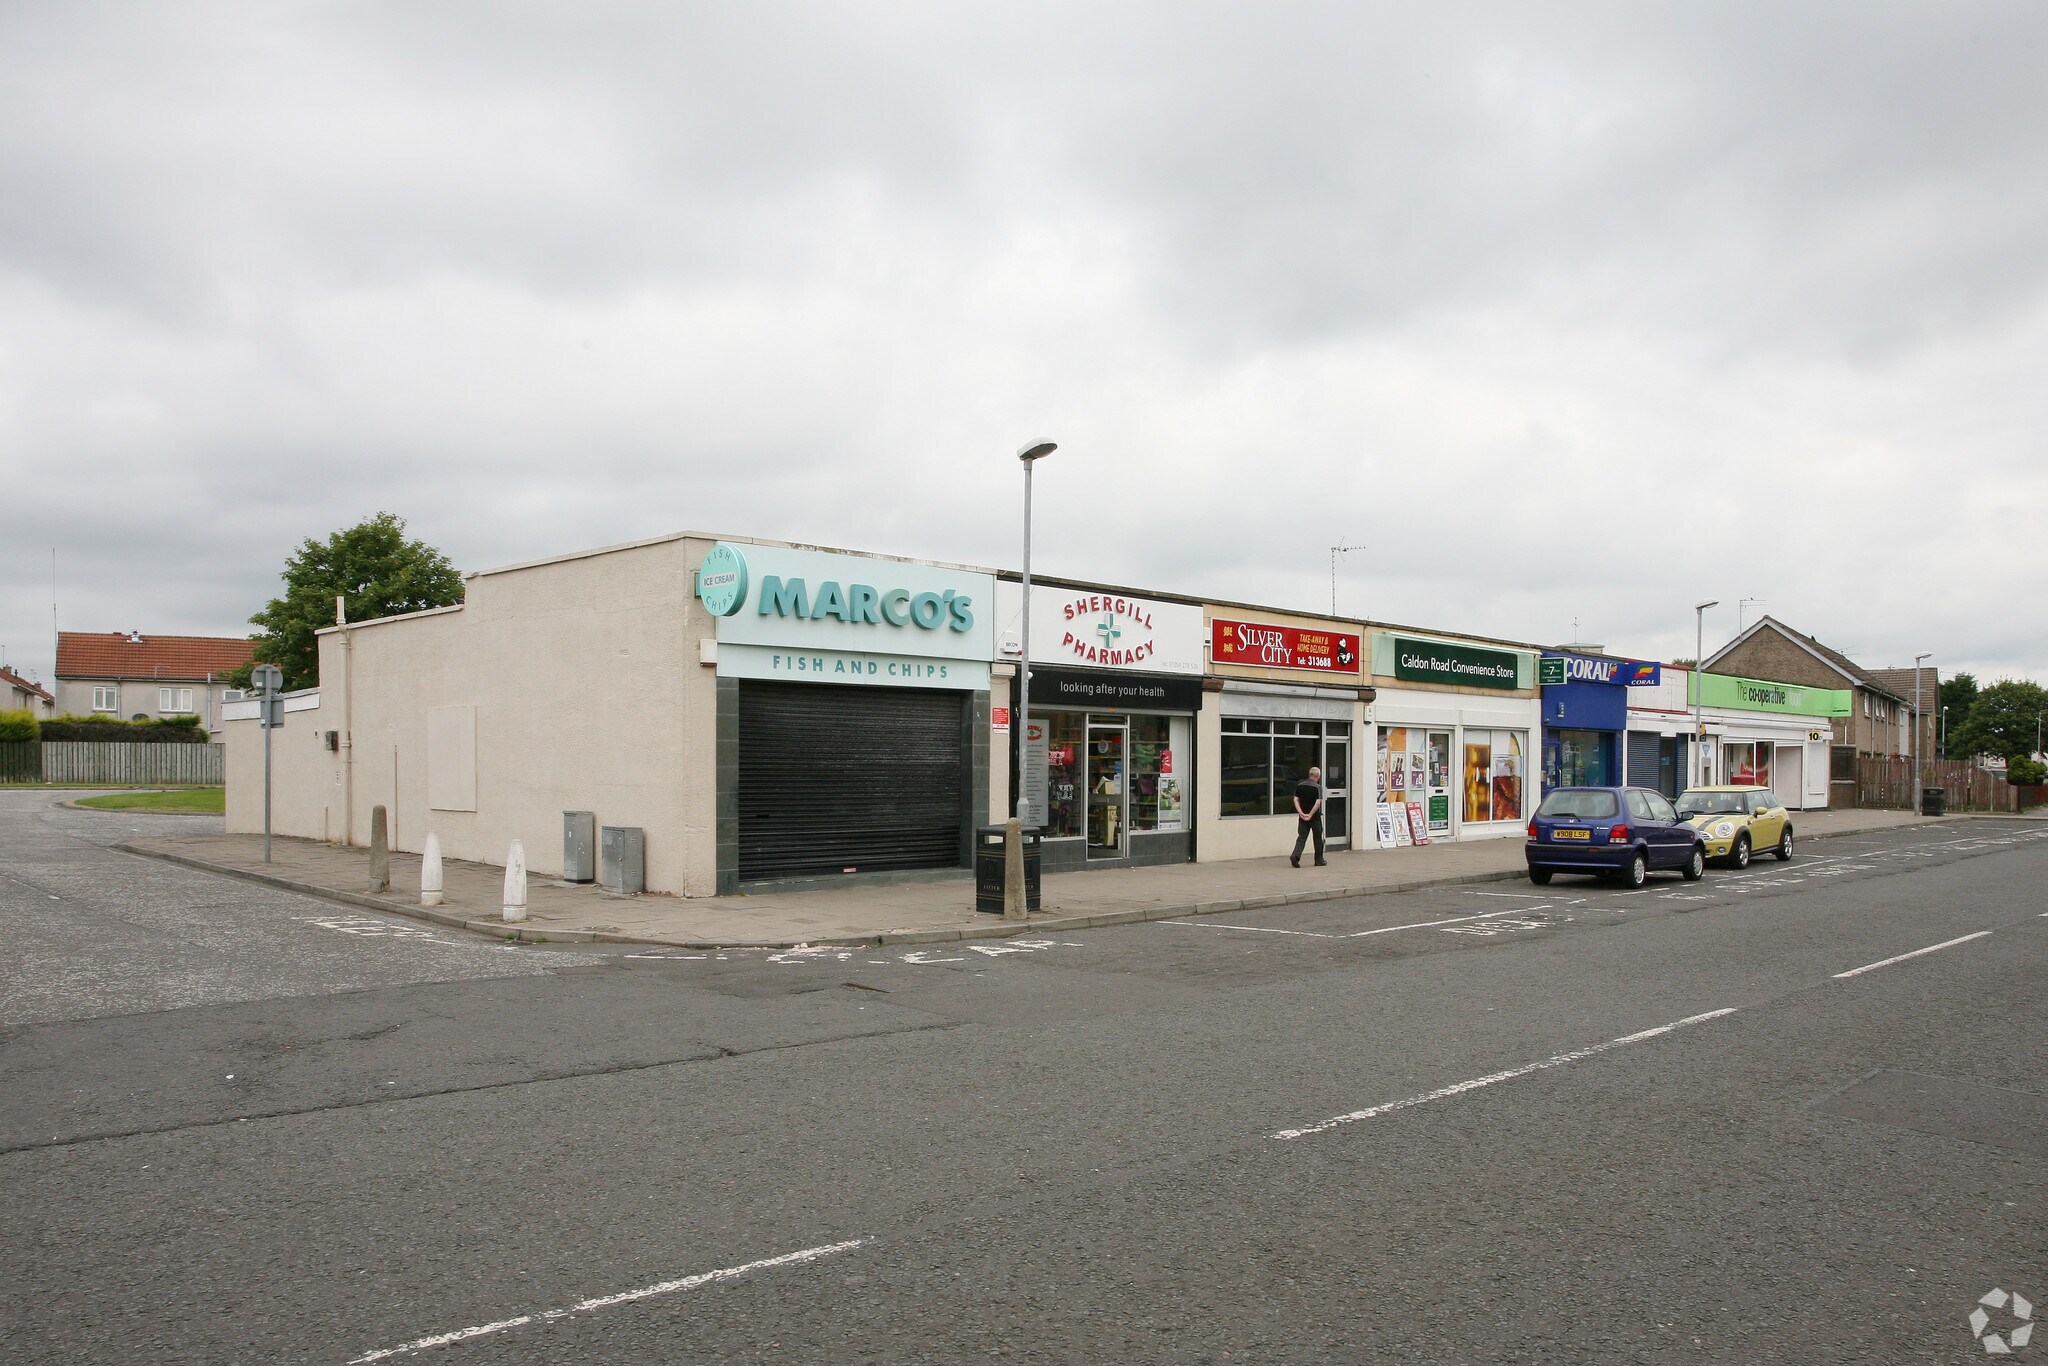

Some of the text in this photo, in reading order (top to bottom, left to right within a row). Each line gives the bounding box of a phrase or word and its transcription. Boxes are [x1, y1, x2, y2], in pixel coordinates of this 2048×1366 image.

[706, 549, 731, 565] FISH
[703, 574, 735, 586] ICE CREAM
[706, 591, 733, 610] CHIPS
[758, 575, 974, 632] MARCO'S
[1064, 596, 1152, 630] SHERGILL
[1062, 631, 1154, 665] PHARMACY
[1237, 624, 1283, 651] SILVER
[1261, 643, 1292, 664] CITY
[1297, 644, 1330, 655] HOME DELIVERY
[773, 655, 948, 678] FISH AND CHIPS
[1401, 654, 1514, 678] Caldon Road Convenience Store
[1549, 666, 1555, 675] 7
[1566, 658, 1610, 681] CORAL
[1060, 681, 1165, 698] looking after your health
[1736, 681, 1747, 701] The
[1749, 687, 1785, 706] co-operative
[1556, 830, 1573, 838] W908
